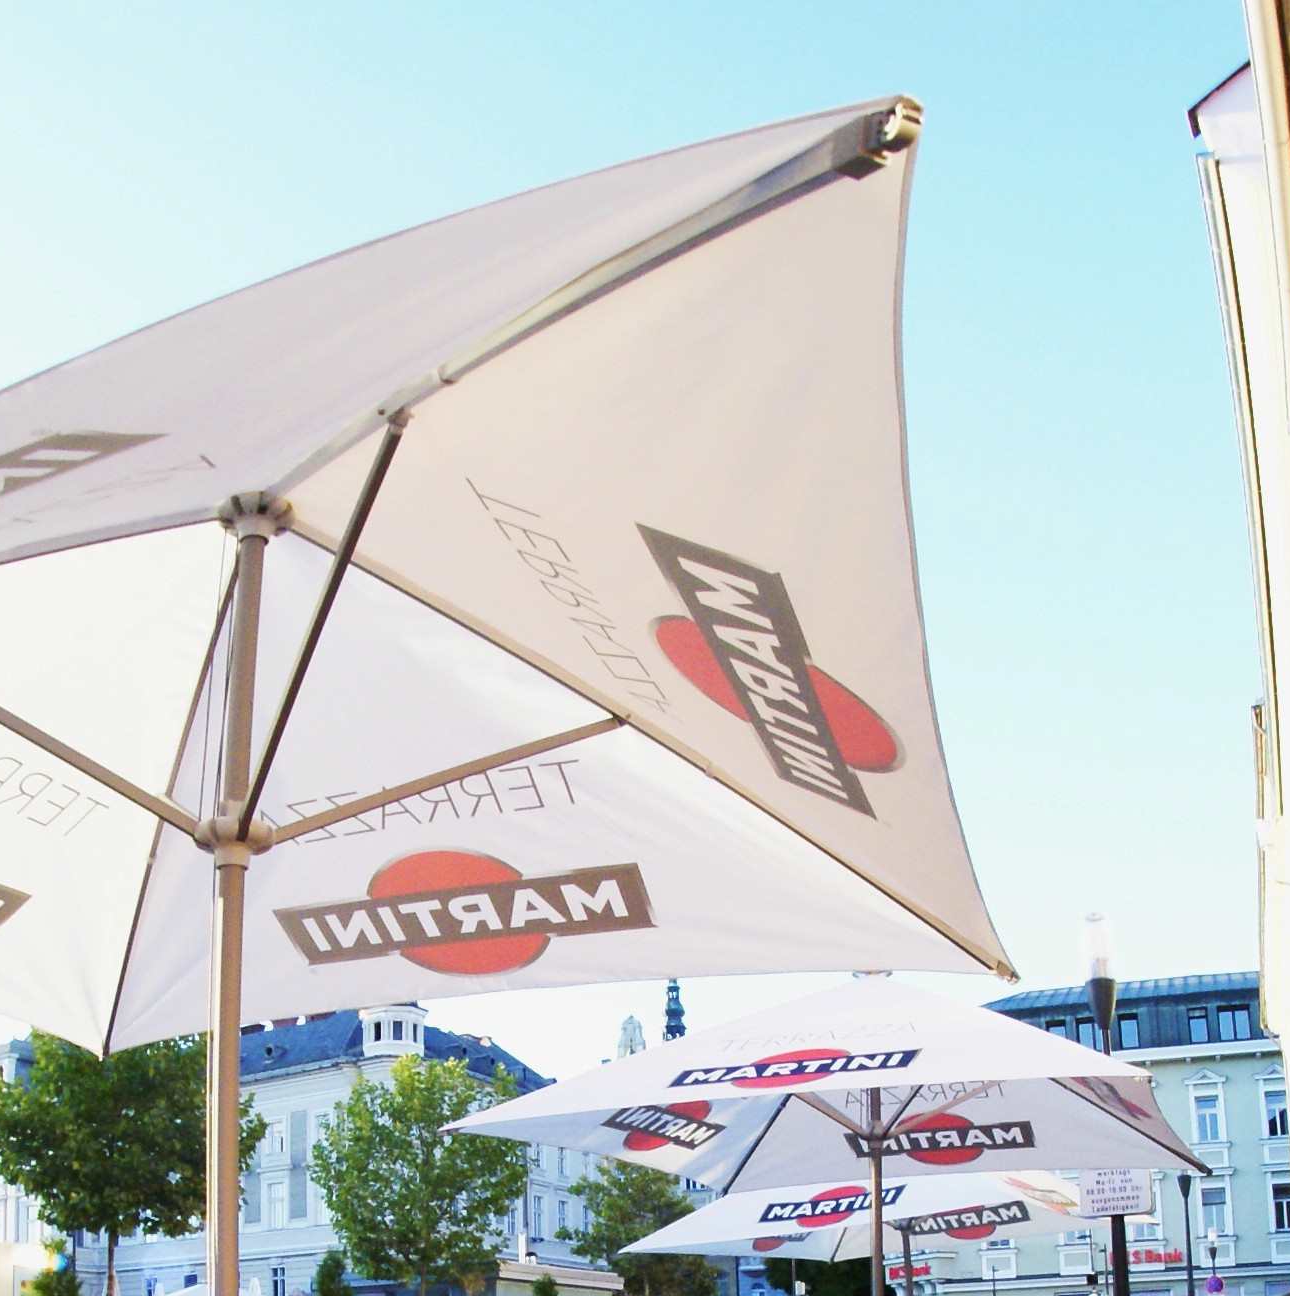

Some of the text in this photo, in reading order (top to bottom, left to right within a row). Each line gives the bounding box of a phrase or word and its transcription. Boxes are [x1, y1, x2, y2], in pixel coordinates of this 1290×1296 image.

[682, 1052, 904, 1085] MARTINI
[767, 1189, 897, 1219] MARTINI
[1144, 1247, 1183, 1264] Bank
